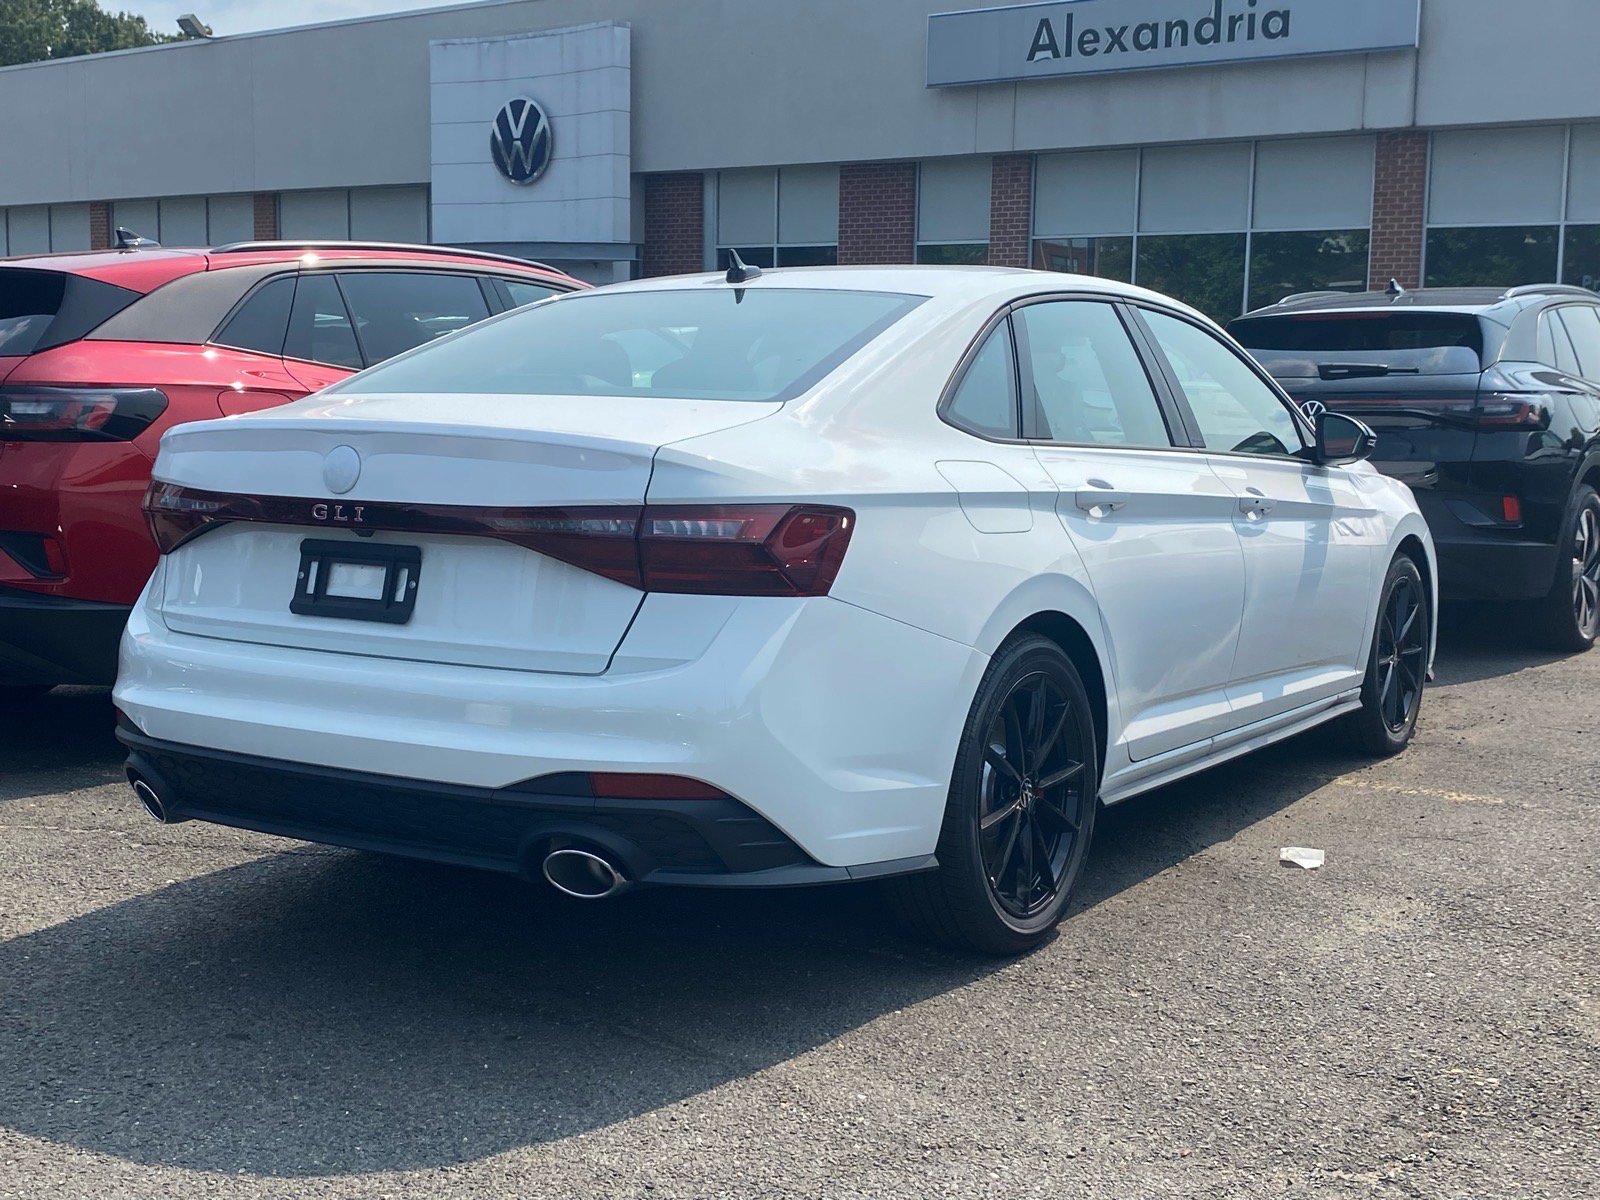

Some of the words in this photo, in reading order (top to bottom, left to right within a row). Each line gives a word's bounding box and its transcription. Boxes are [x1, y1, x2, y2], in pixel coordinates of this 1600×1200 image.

[1026, 0, 1290, 61] Alexandria
[491, 97, 549, 181] VW
[312, 503, 364, 521] GLI
